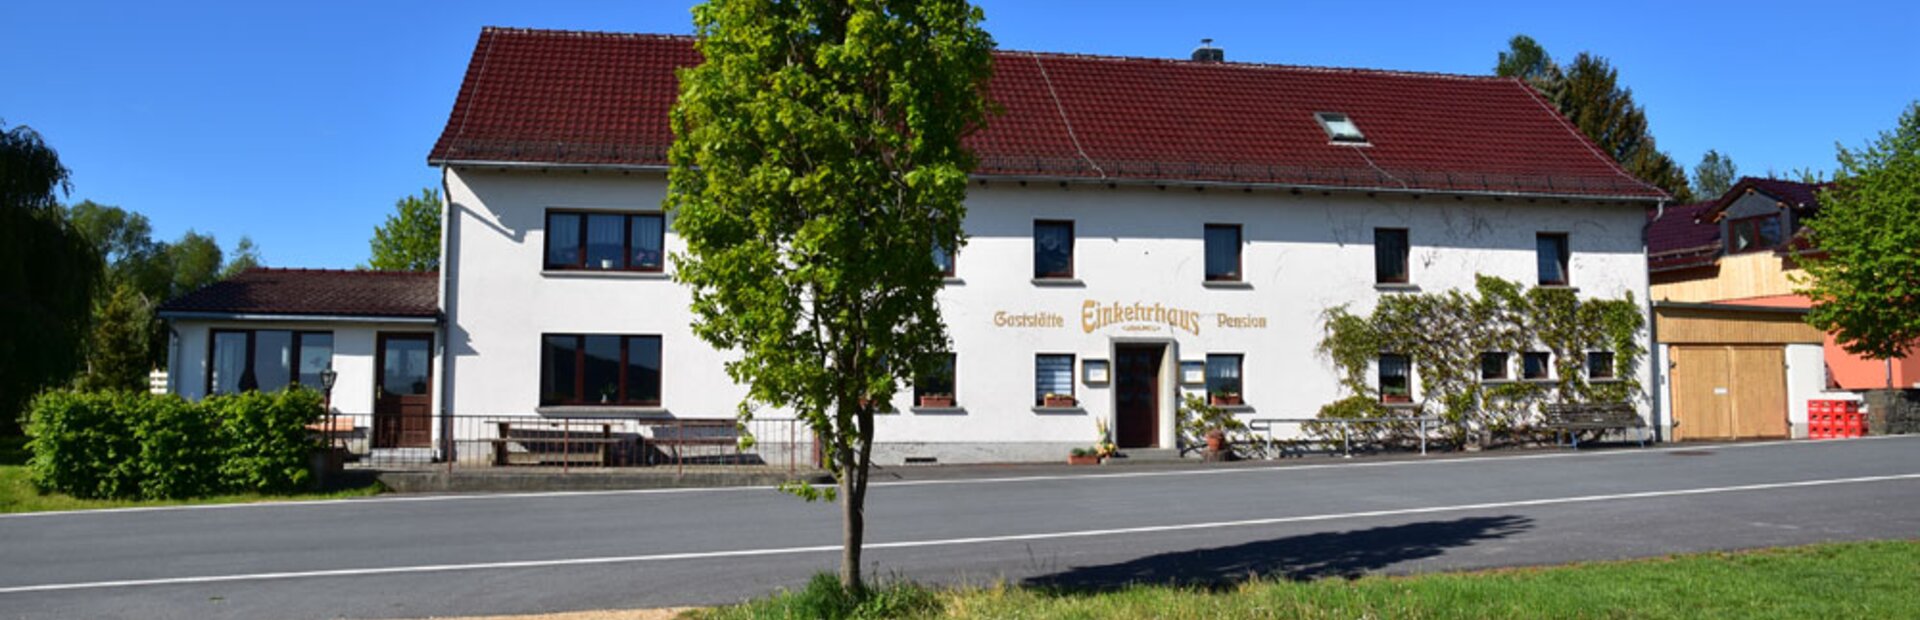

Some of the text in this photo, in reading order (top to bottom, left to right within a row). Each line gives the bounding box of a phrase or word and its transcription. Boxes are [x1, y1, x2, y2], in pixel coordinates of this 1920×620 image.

[994, 311, 1064, 328] Gaststätte
[1081, 299, 1200, 336] Einkehrhaus
[1217, 313, 1267, 329] Pension
